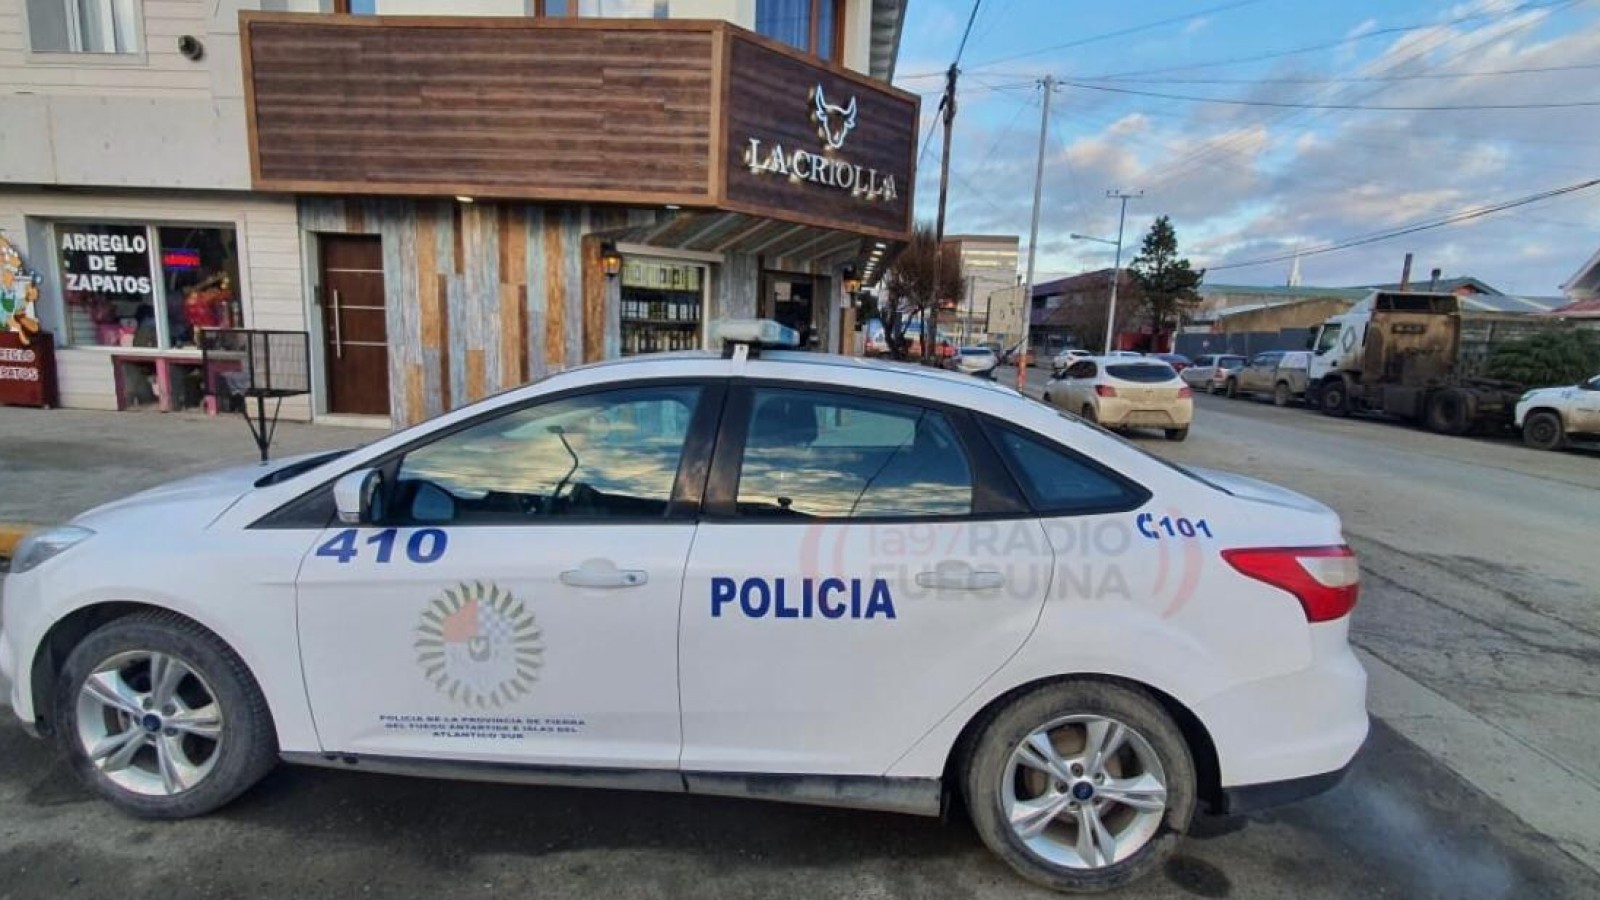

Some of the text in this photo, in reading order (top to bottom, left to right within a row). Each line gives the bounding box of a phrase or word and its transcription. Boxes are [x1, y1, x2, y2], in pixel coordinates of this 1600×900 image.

[747, 137, 899, 200] LA CRIOLLA
[62, 232, 147, 253] ARREGLO
[88, 254, 117, 272] DE
[65, 273, 151, 294] ZAPATOS
[1159, 515, 1214, 538] 101
[316, 527, 448, 564] 410
[710, 577, 897, 619] POLICIA
